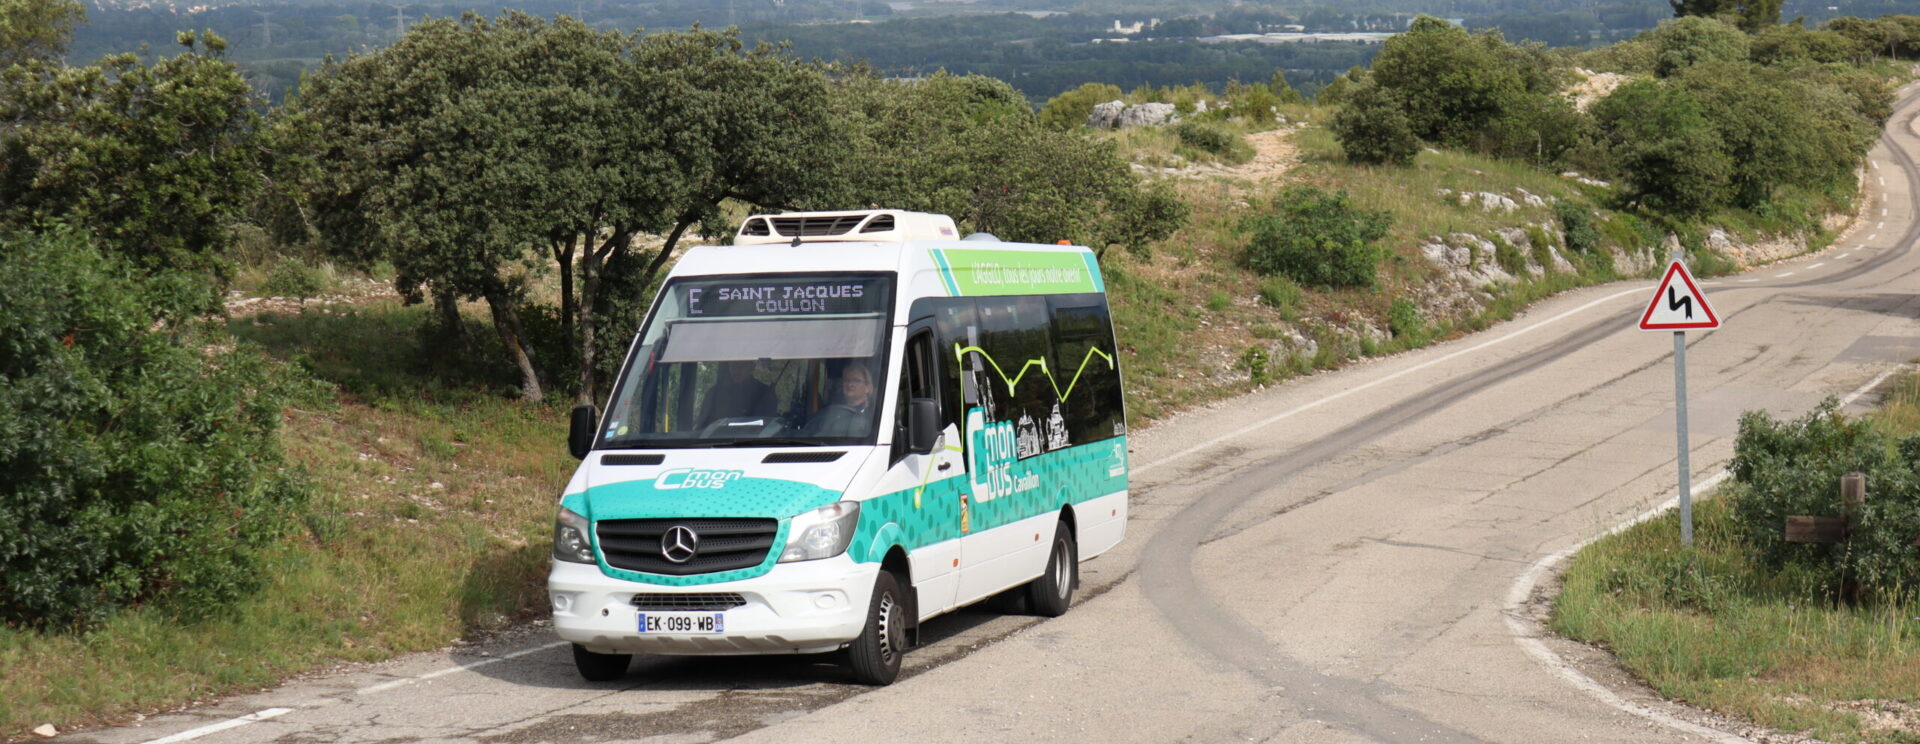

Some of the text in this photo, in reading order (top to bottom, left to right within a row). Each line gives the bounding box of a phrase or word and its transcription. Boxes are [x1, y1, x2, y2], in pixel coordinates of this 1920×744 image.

[689, 288, 703, 314] E
[718, 285, 864, 300] SAINT JACQUES
[755, 299, 825, 313] COULON
[1014, 470, 1039, 493] Cavaillon
